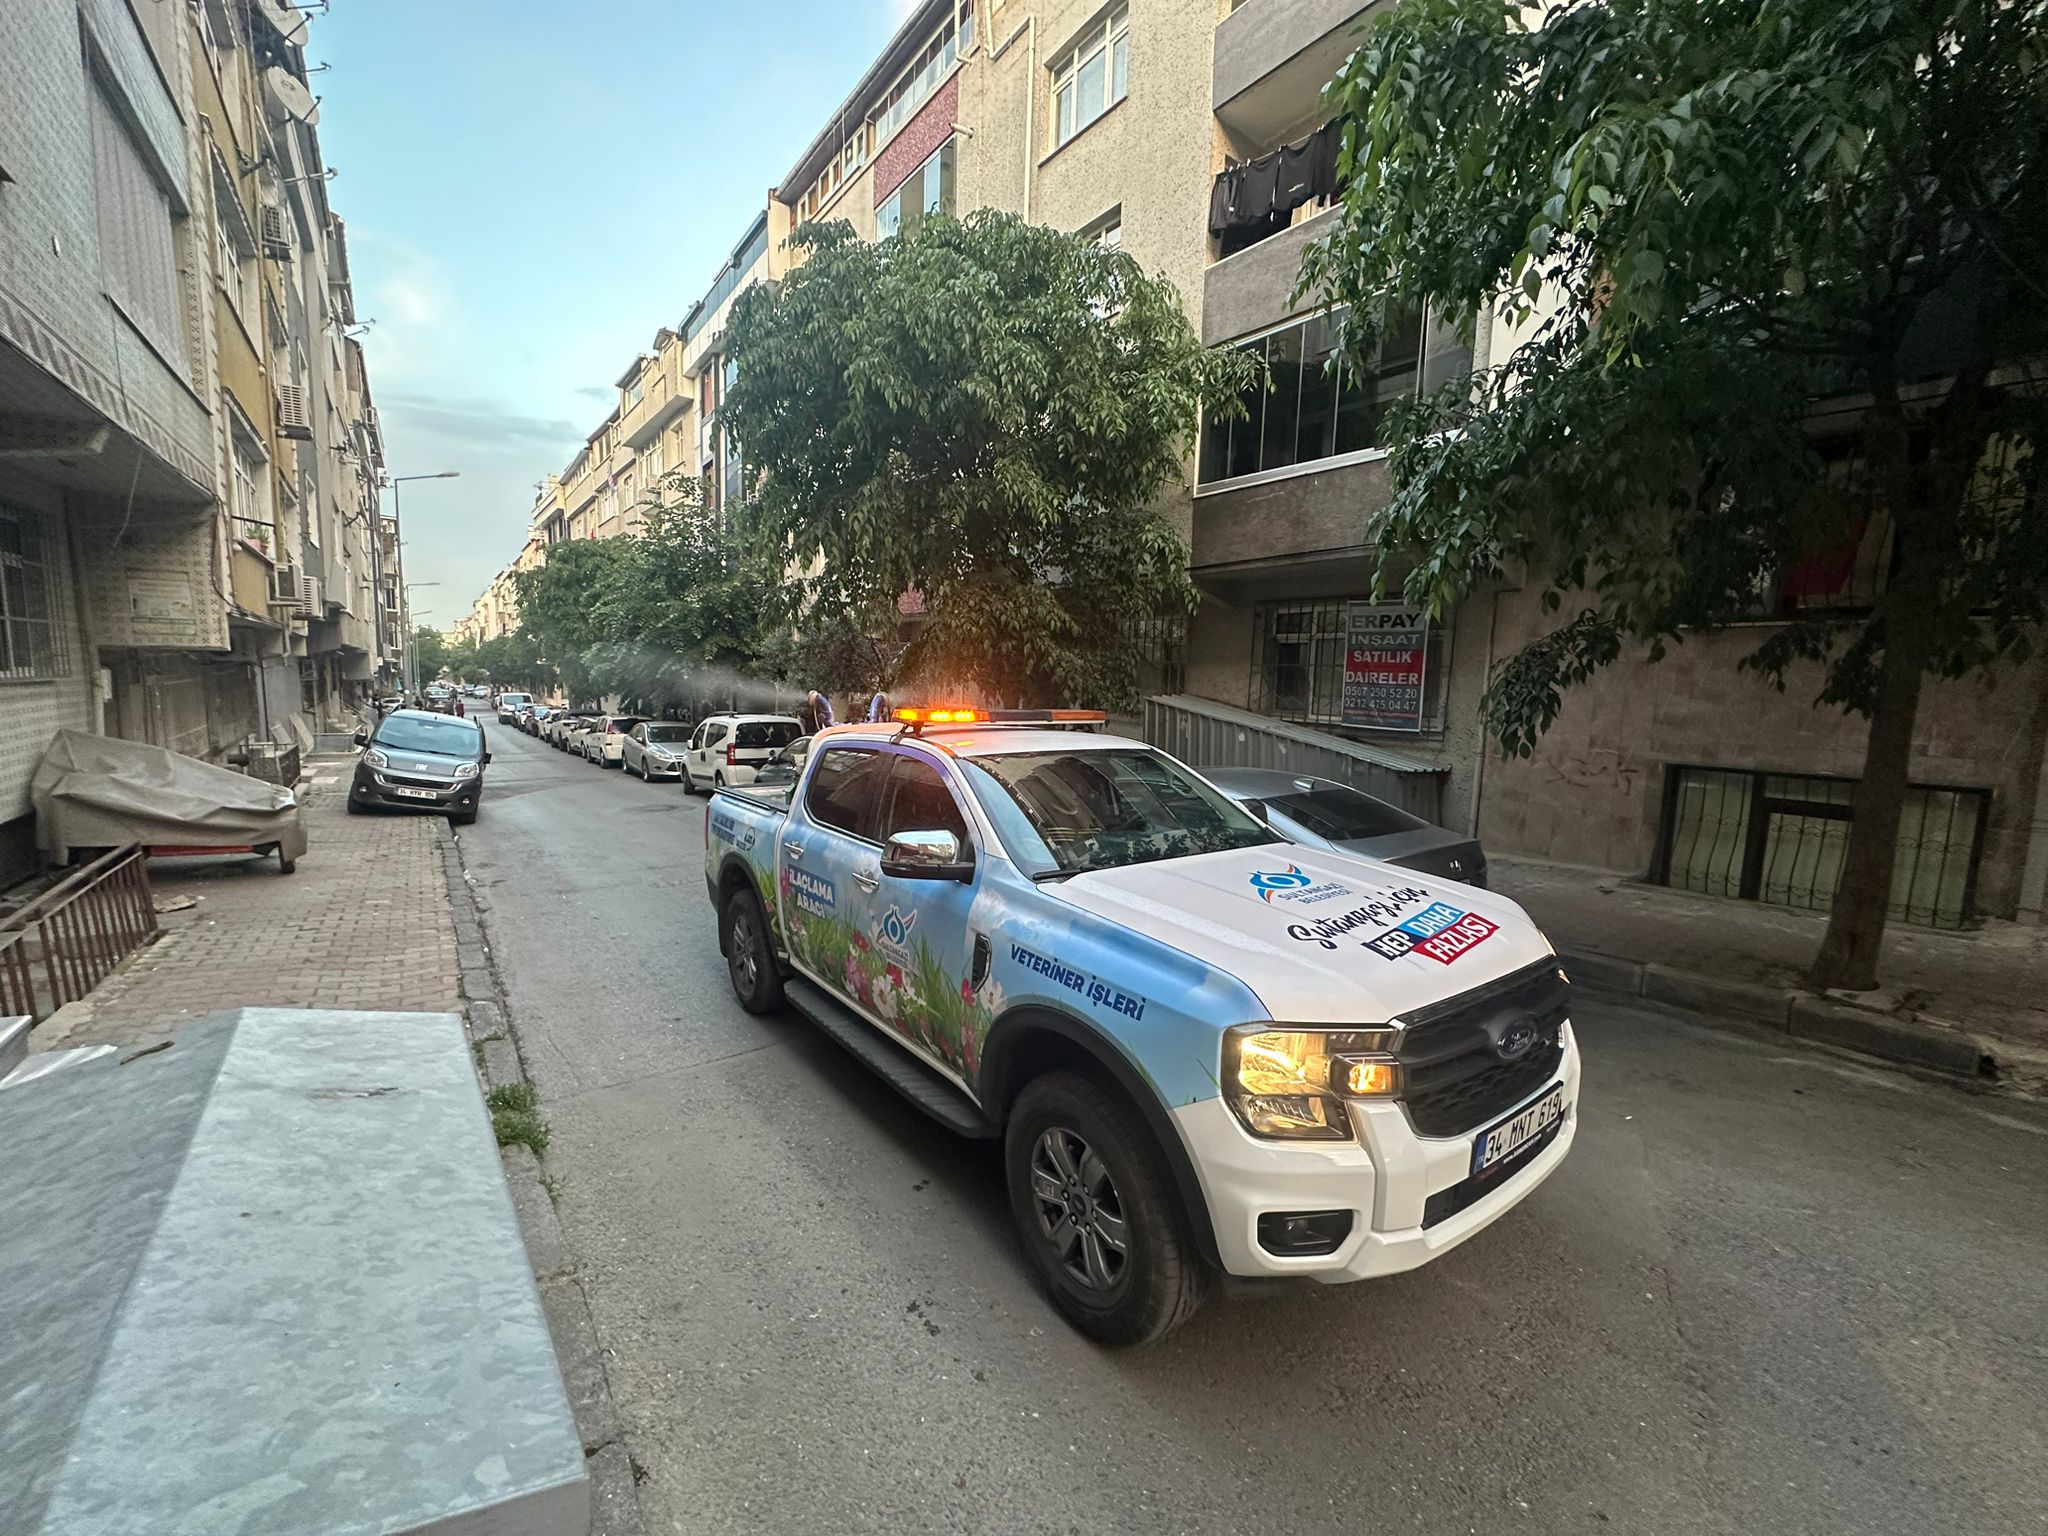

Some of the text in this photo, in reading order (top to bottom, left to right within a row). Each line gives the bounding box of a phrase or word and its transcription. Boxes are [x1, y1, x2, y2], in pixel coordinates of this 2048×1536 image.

[1352, 613, 1420, 628] ERPAY
[1354, 651, 1412, 663] SATILIK
[1346, 669, 1418, 684] DAİRELER
[1345, 698, 1416, 711] 0212 475 04 47
[1371, 688, 1386, 697] 250
[1389, 689, 1402, 698] 52
[1405, 689, 1417, 698] 20
[789, 868, 834, 903] İLAÇLAMA
[1370, 904, 1460, 957] HEP DAHA
[1424, 916, 1493, 961] FAZLASI
[1010, 944, 1146, 1021] VETERİNER İŞLERİ
[1485, 1132, 1502, 1163] 34
[1509, 1110, 1534, 1148] MNT
[1538, 1092, 1560, 1127] 619
